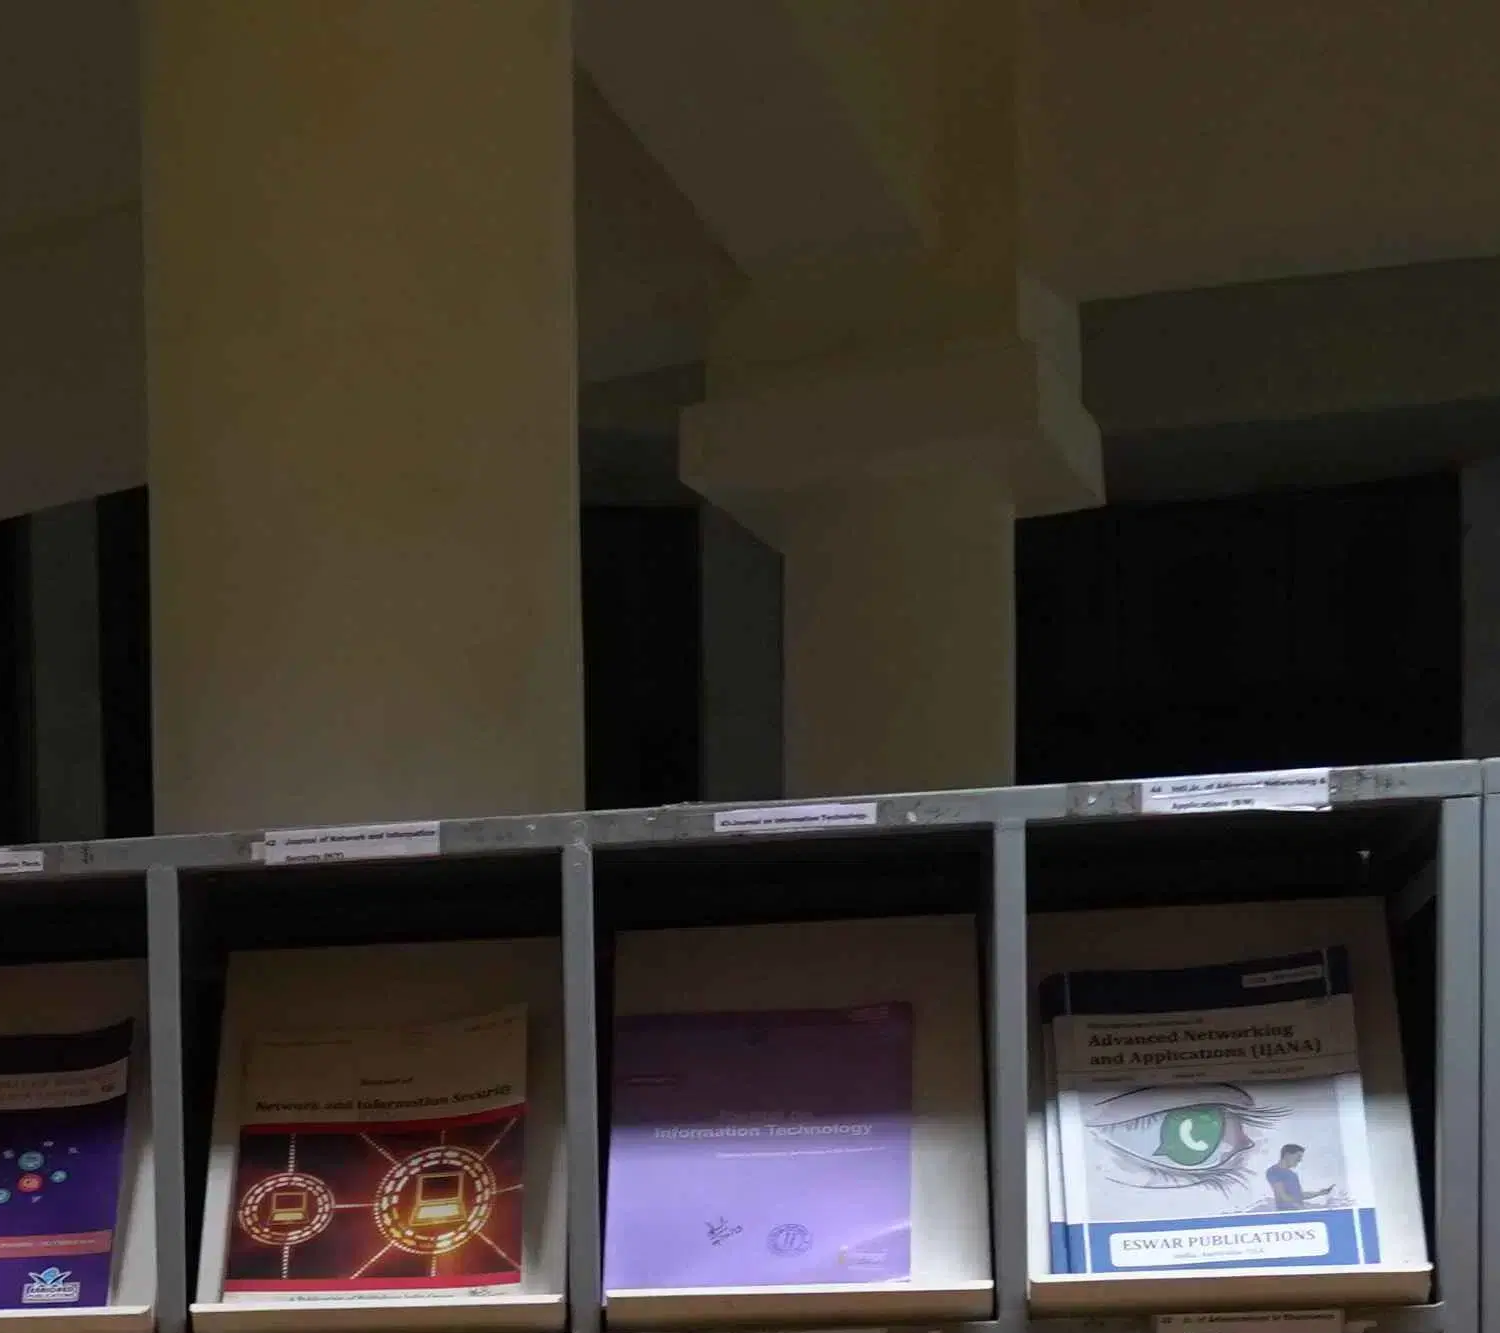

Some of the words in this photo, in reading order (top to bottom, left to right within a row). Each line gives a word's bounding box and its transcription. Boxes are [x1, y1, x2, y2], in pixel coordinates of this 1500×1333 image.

[655, 1124, 761, 1140] Information
[767, 1123, 873, 1139] Technology
[1122, 1234, 1184, 1252] ESWAR
[1188, 1228, 1317, 1249] PUBLICATIONS
